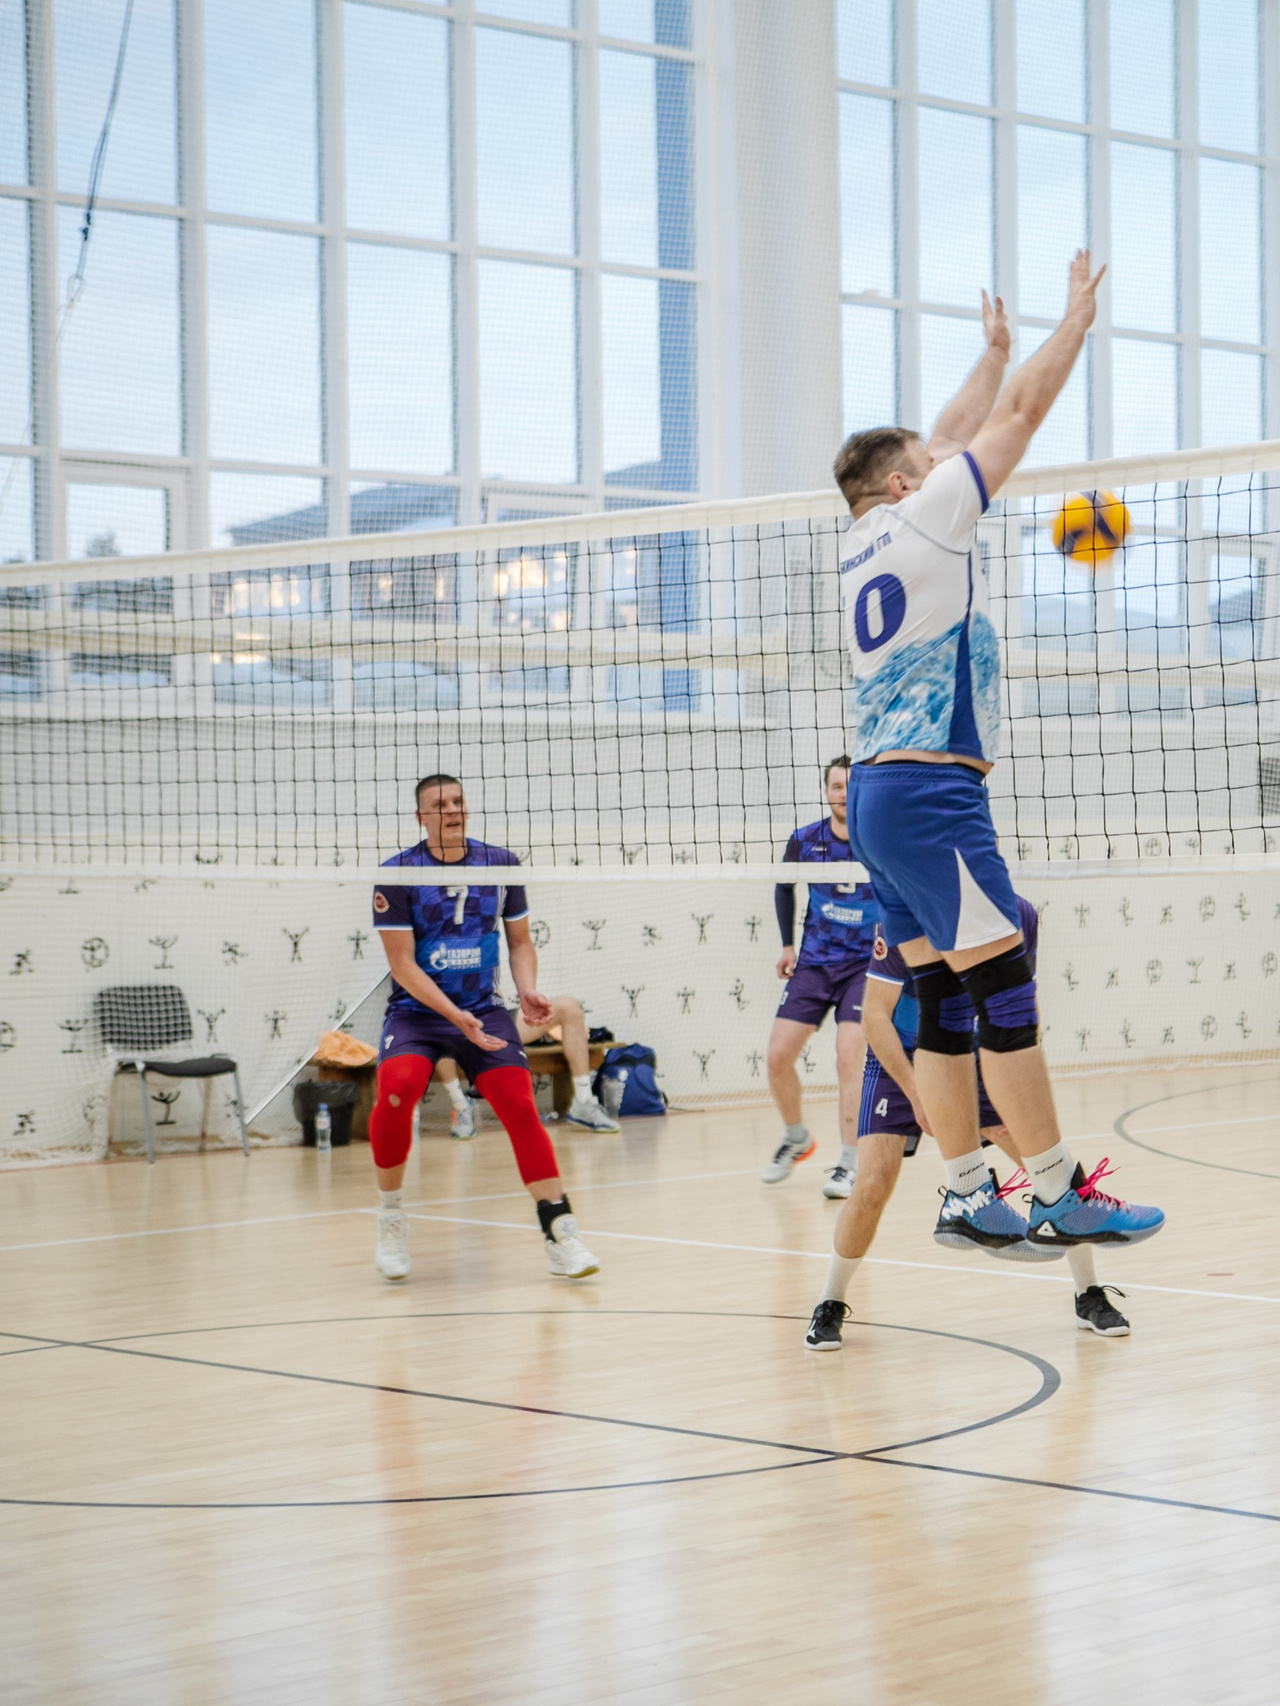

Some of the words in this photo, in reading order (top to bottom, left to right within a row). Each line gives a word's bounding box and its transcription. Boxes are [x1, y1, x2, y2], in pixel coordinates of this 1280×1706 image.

[855, 573, 906, 653] 0
[446, 885, 469, 925] 7
[874, 1097, 889, 1118] 4
